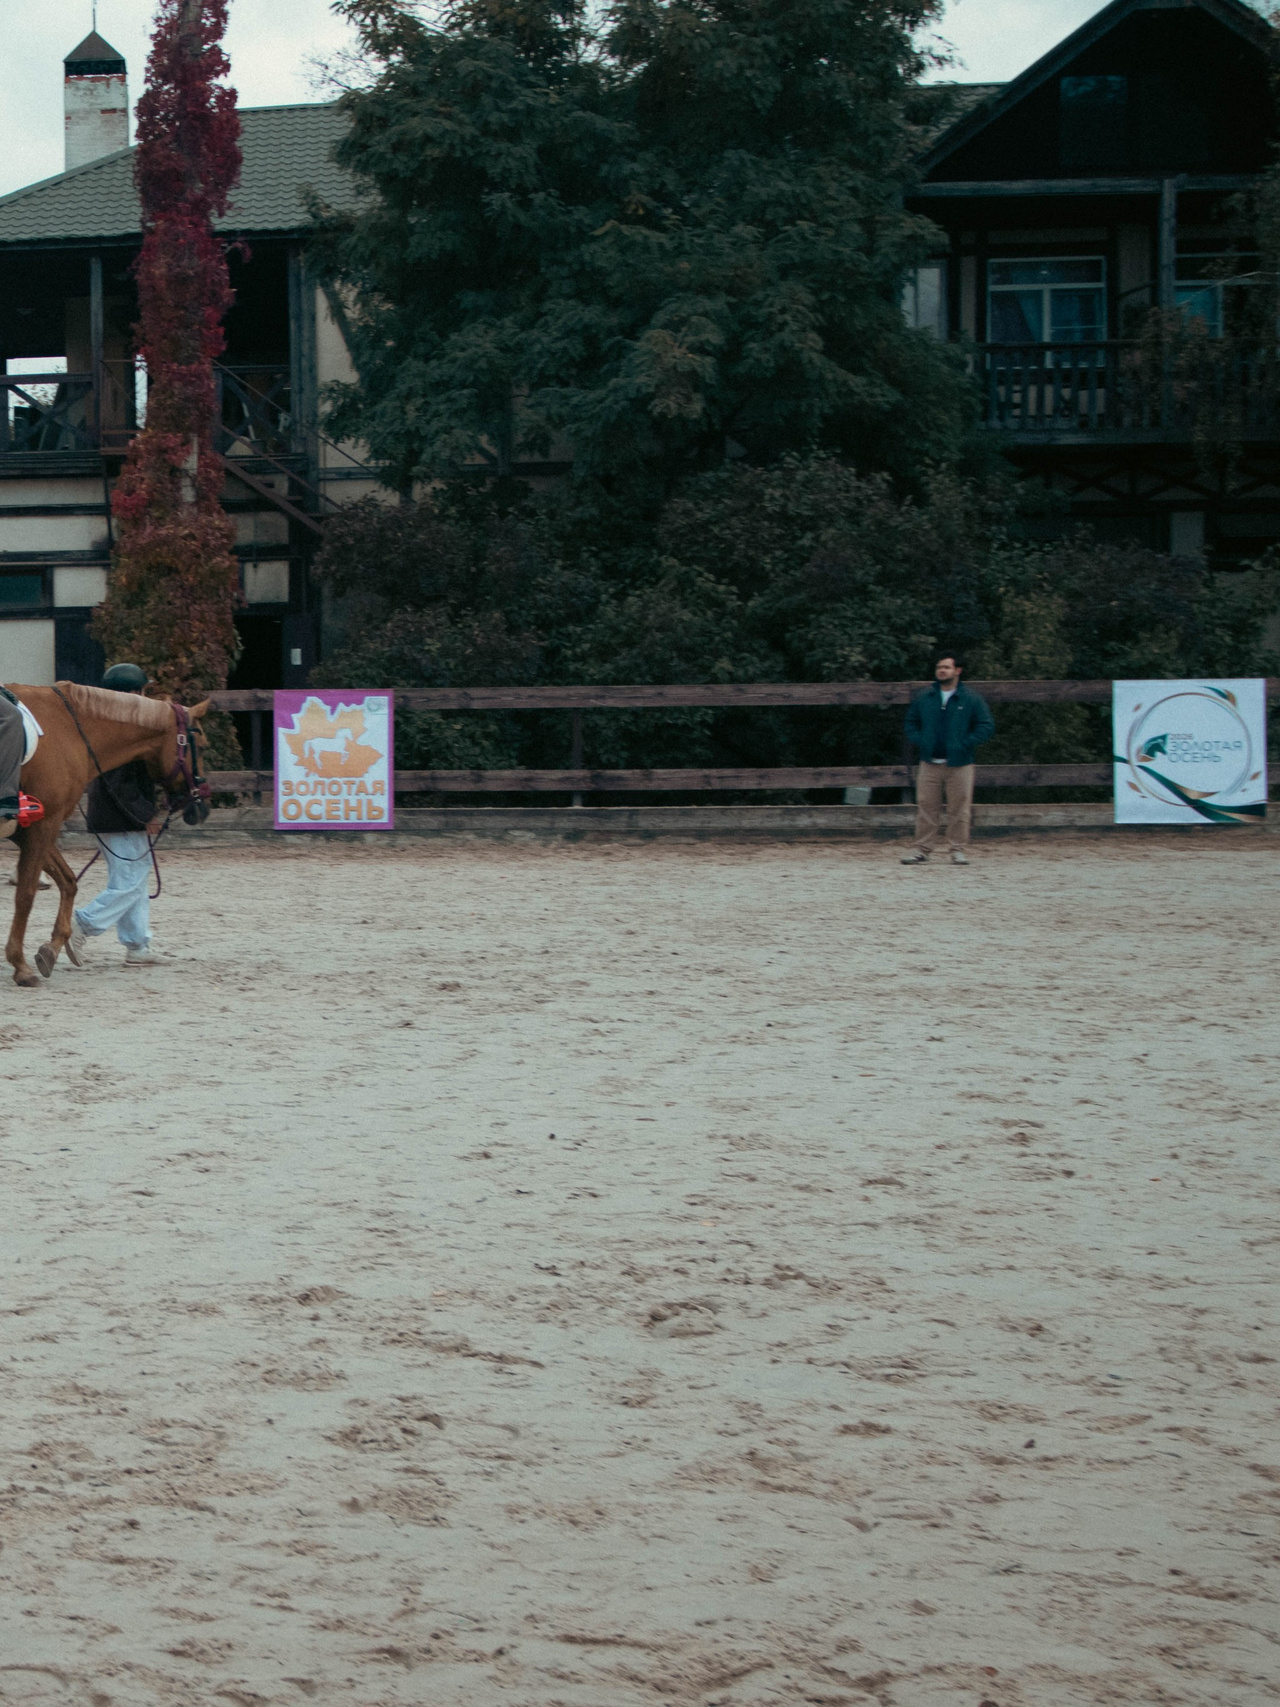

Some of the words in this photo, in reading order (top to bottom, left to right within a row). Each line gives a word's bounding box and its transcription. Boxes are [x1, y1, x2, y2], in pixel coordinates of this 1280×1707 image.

[1168, 740, 1242, 752] ЗОЛОТАЯ
[1168, 752, 1222, 763] ОСЕНЬ
[281, 780, 385, 796] ЗОЛОТАЯ
[281, 799, 385, 821] ОСЕНЬ
